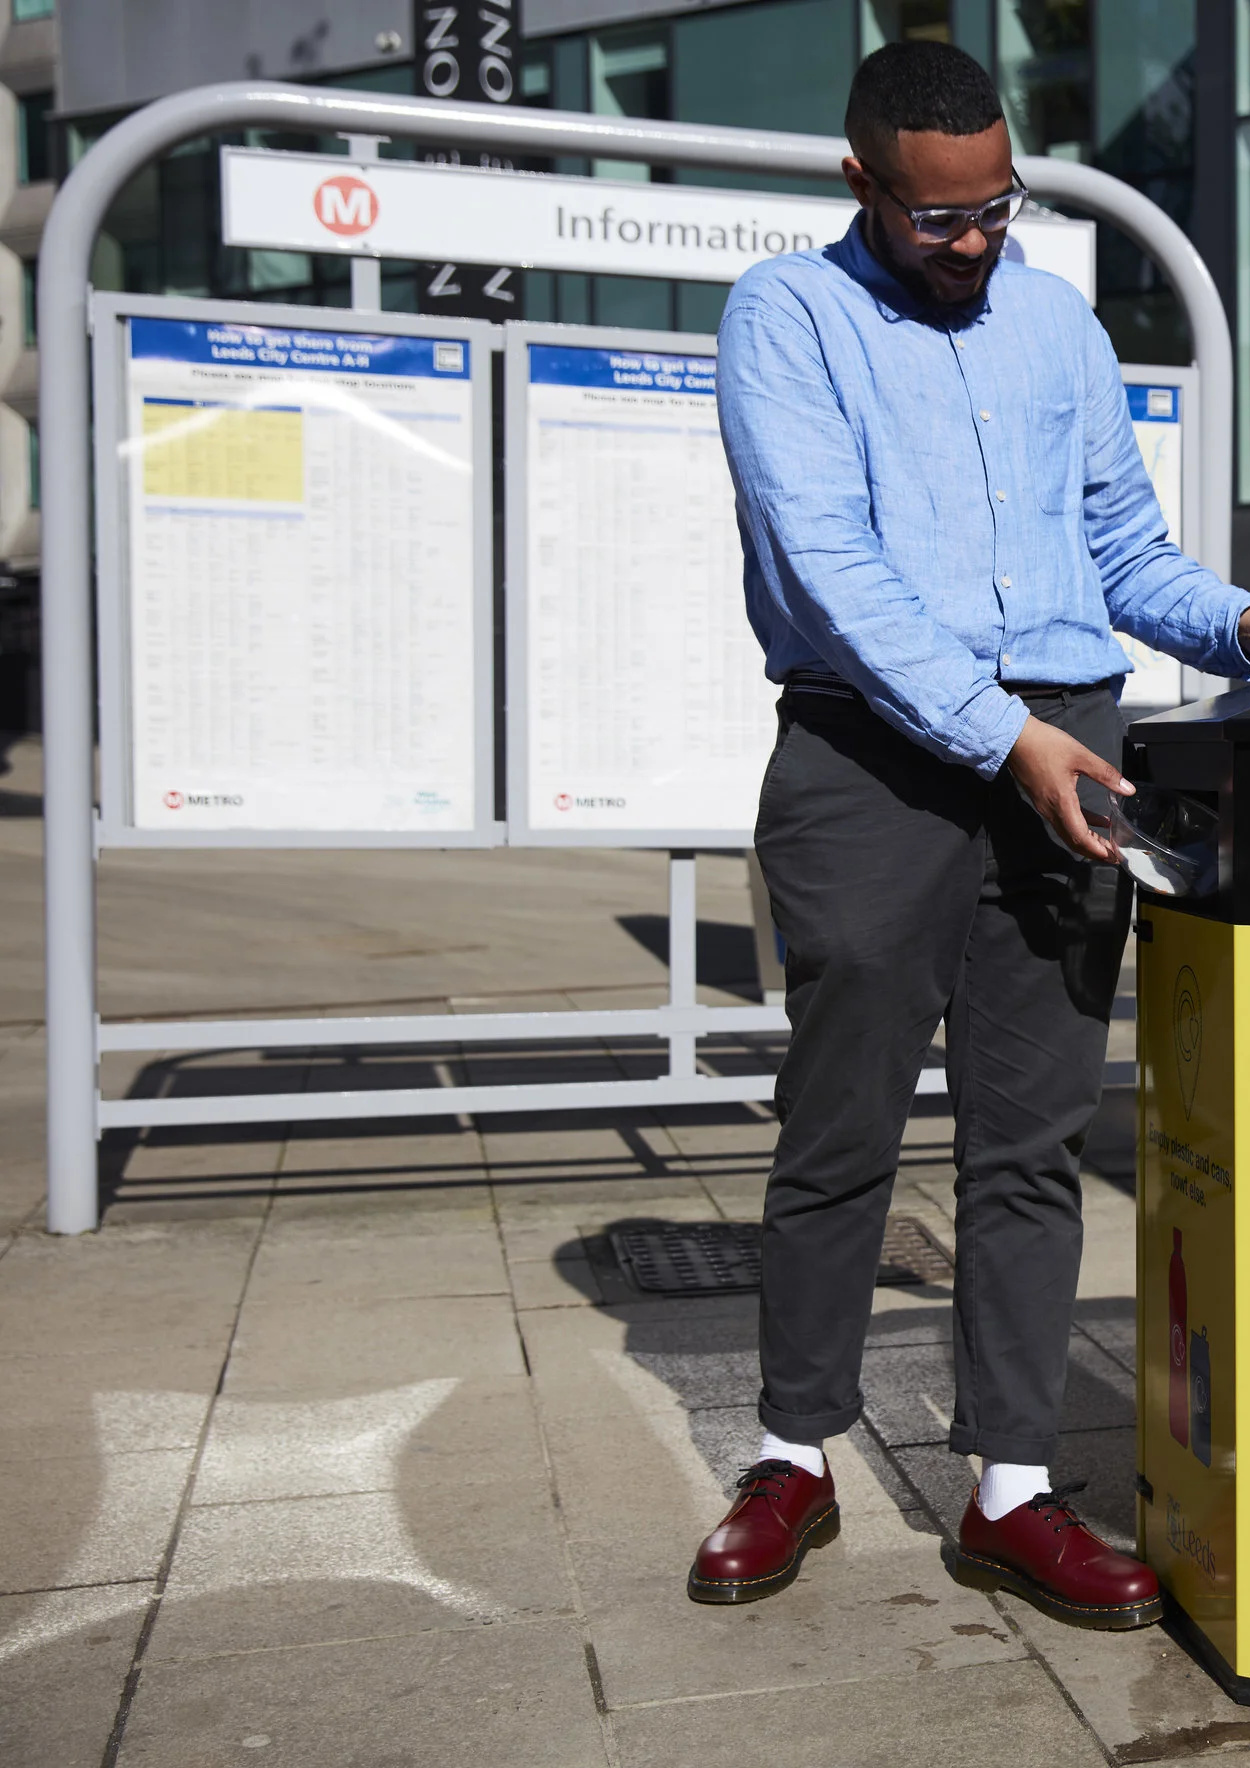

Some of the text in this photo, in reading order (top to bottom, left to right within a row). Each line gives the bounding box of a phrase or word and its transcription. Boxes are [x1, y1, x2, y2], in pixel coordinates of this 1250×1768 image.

[423, 0, 460, 97] ON
[319, 182, 814, 255] M Information
[207, 328, 242, 344] How
[211, 344, 256, 361] Leeds
[257, 346, 289, 365] City
[613, 371, 717, 390] Leeds City Cent
[1148, 1121, 1232, 1193] Empty plastic and cans,
[1170, 1171, 1207, 1208] nowt else.
[1182, 1518, 1216, 1581] Leeds
